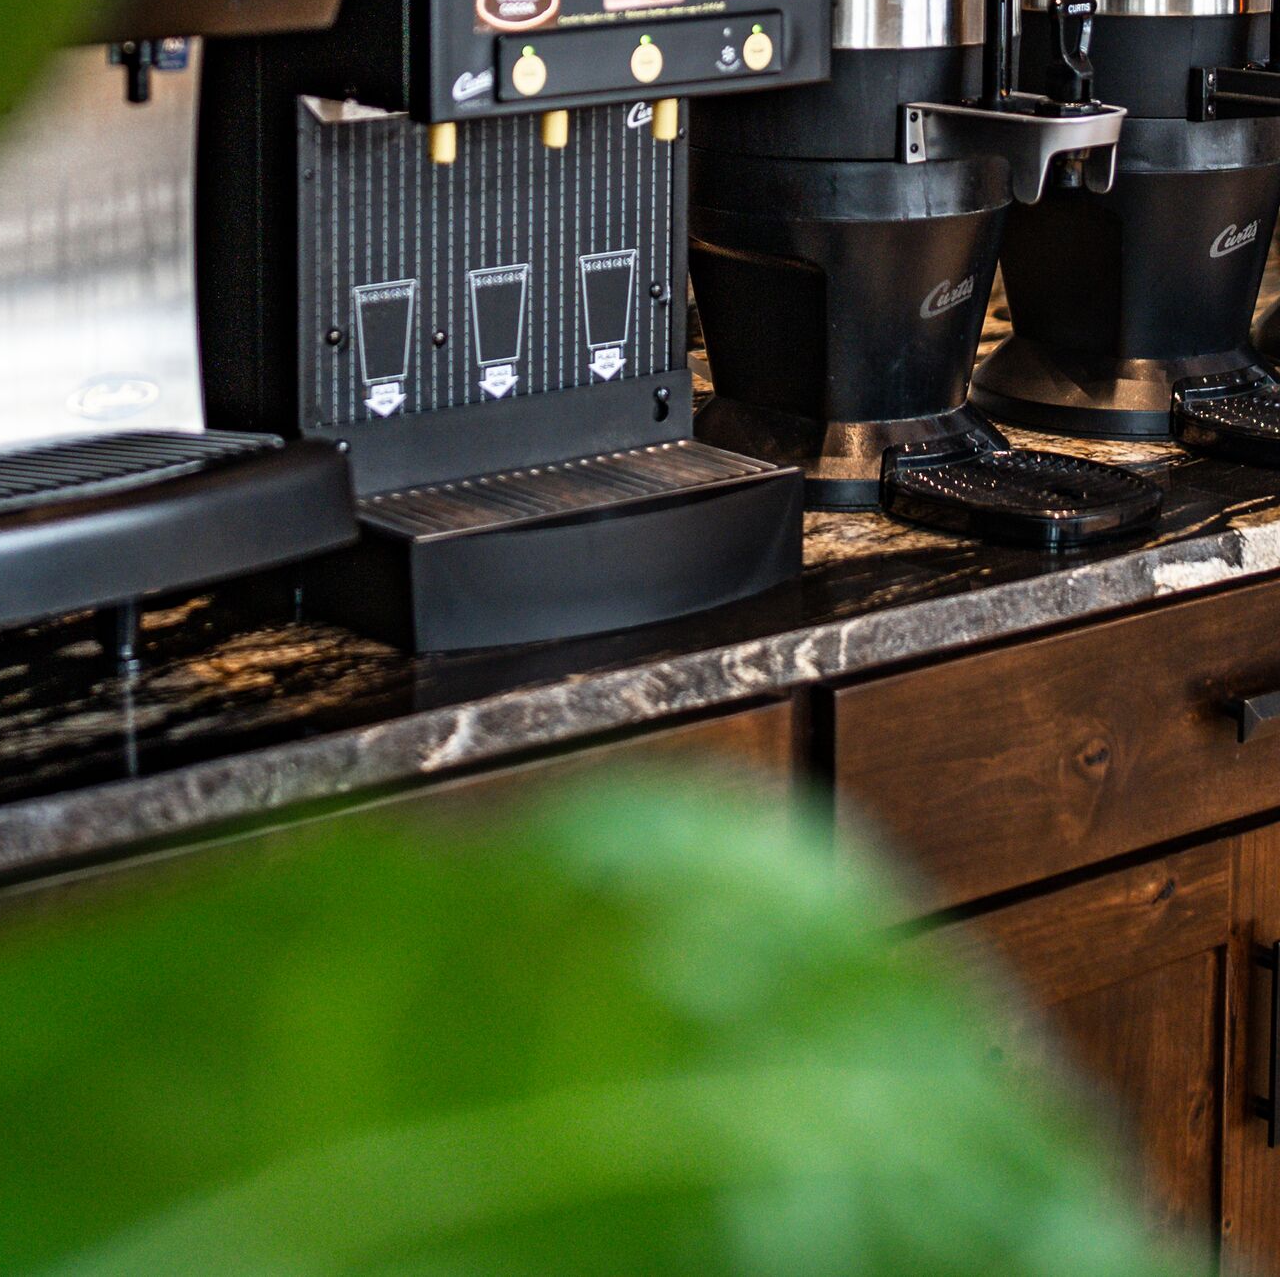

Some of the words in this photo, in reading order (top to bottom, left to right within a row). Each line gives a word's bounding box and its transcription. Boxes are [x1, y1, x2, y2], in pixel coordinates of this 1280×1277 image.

[1067, 2, 1091, 15] CURTIS
[1209, 219, 1259, 258] Curtis
[920, 275, 974, 319] Curtis
